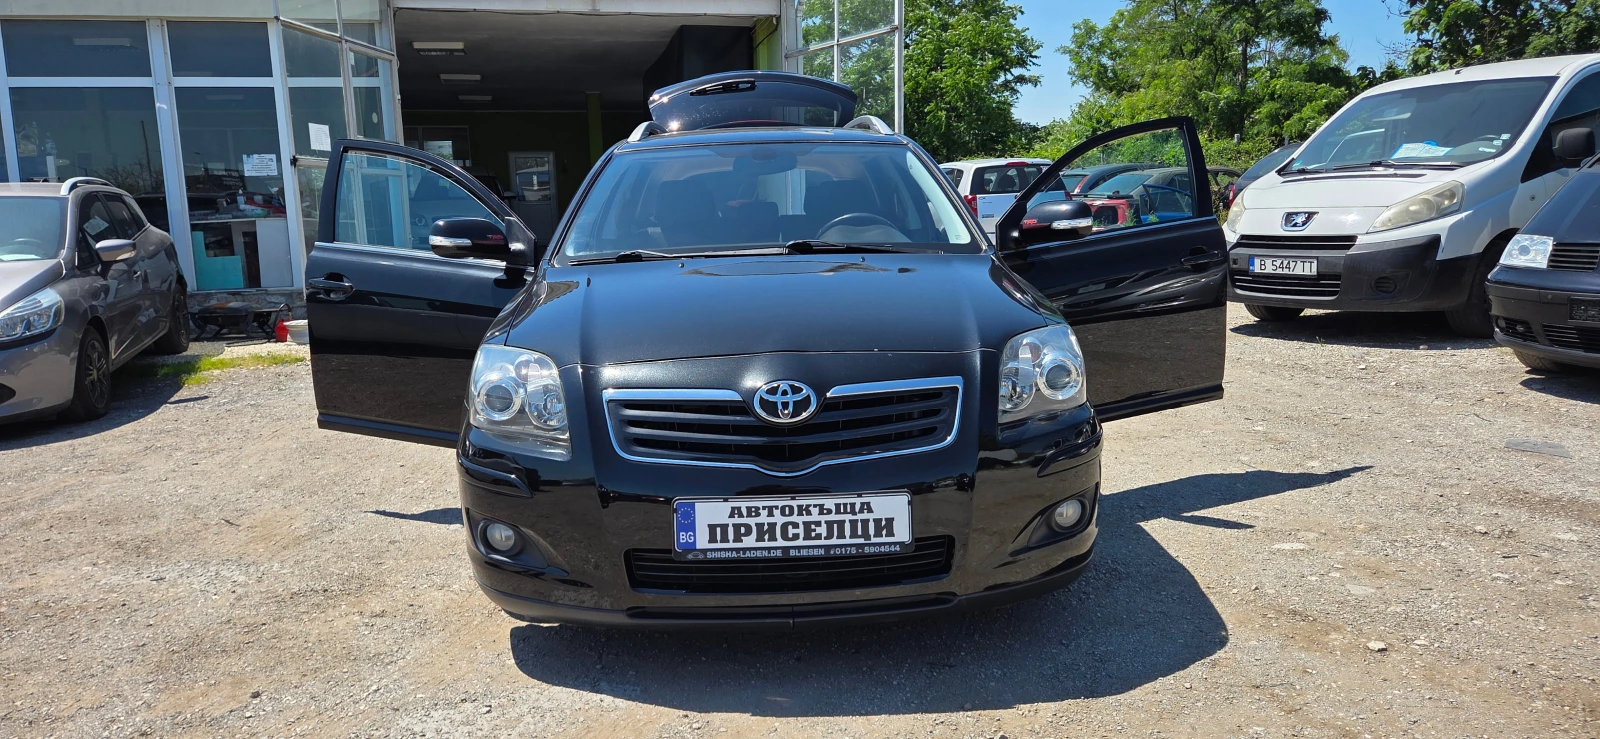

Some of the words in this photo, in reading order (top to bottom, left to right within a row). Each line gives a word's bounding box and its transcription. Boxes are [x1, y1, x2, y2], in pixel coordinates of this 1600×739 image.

[1259, 259, 1267, 271] B
[1271, 260, 1298, 273] 5447
[1300, 260, 1315, 274] TT
[728, 501, 874, 519] АВТОКЪЩА
[679, 531, 695, 543] BG
[707, 517, 896, 545] ПРИСЕЛЦИ
[706, 549, 783, 559] SHISHA-LADEN.DE
[789, 548, 825, 557] BLIESEN
[864, 544, 901, 553] 5904544
